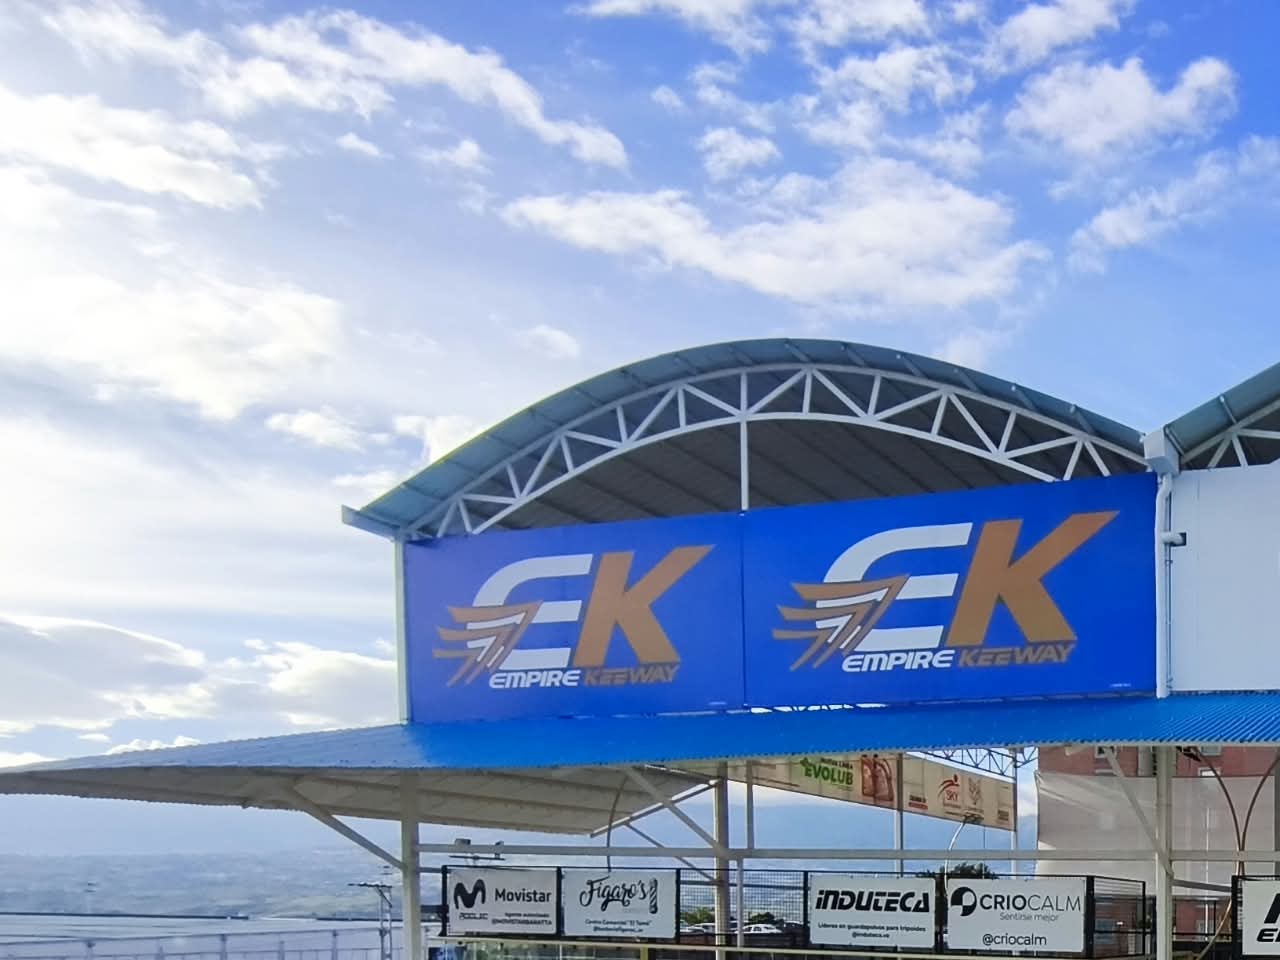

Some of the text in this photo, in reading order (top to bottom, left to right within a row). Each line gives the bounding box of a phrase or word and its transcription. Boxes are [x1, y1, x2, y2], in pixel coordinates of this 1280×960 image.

[842, 643, 1078, 673] EMPIRE KEEWAY
[488, 664, 680, 689] EMPIRE KEEWAY
[804, 765, 854, 786] EVOLUB
[494, 888, 552, 903] Movistar
[579, 876, 648, 912] Figaro's
[979, 894, 1081, 912] CRIOCALM
[982, 932, 1048, 946] @criocalm
